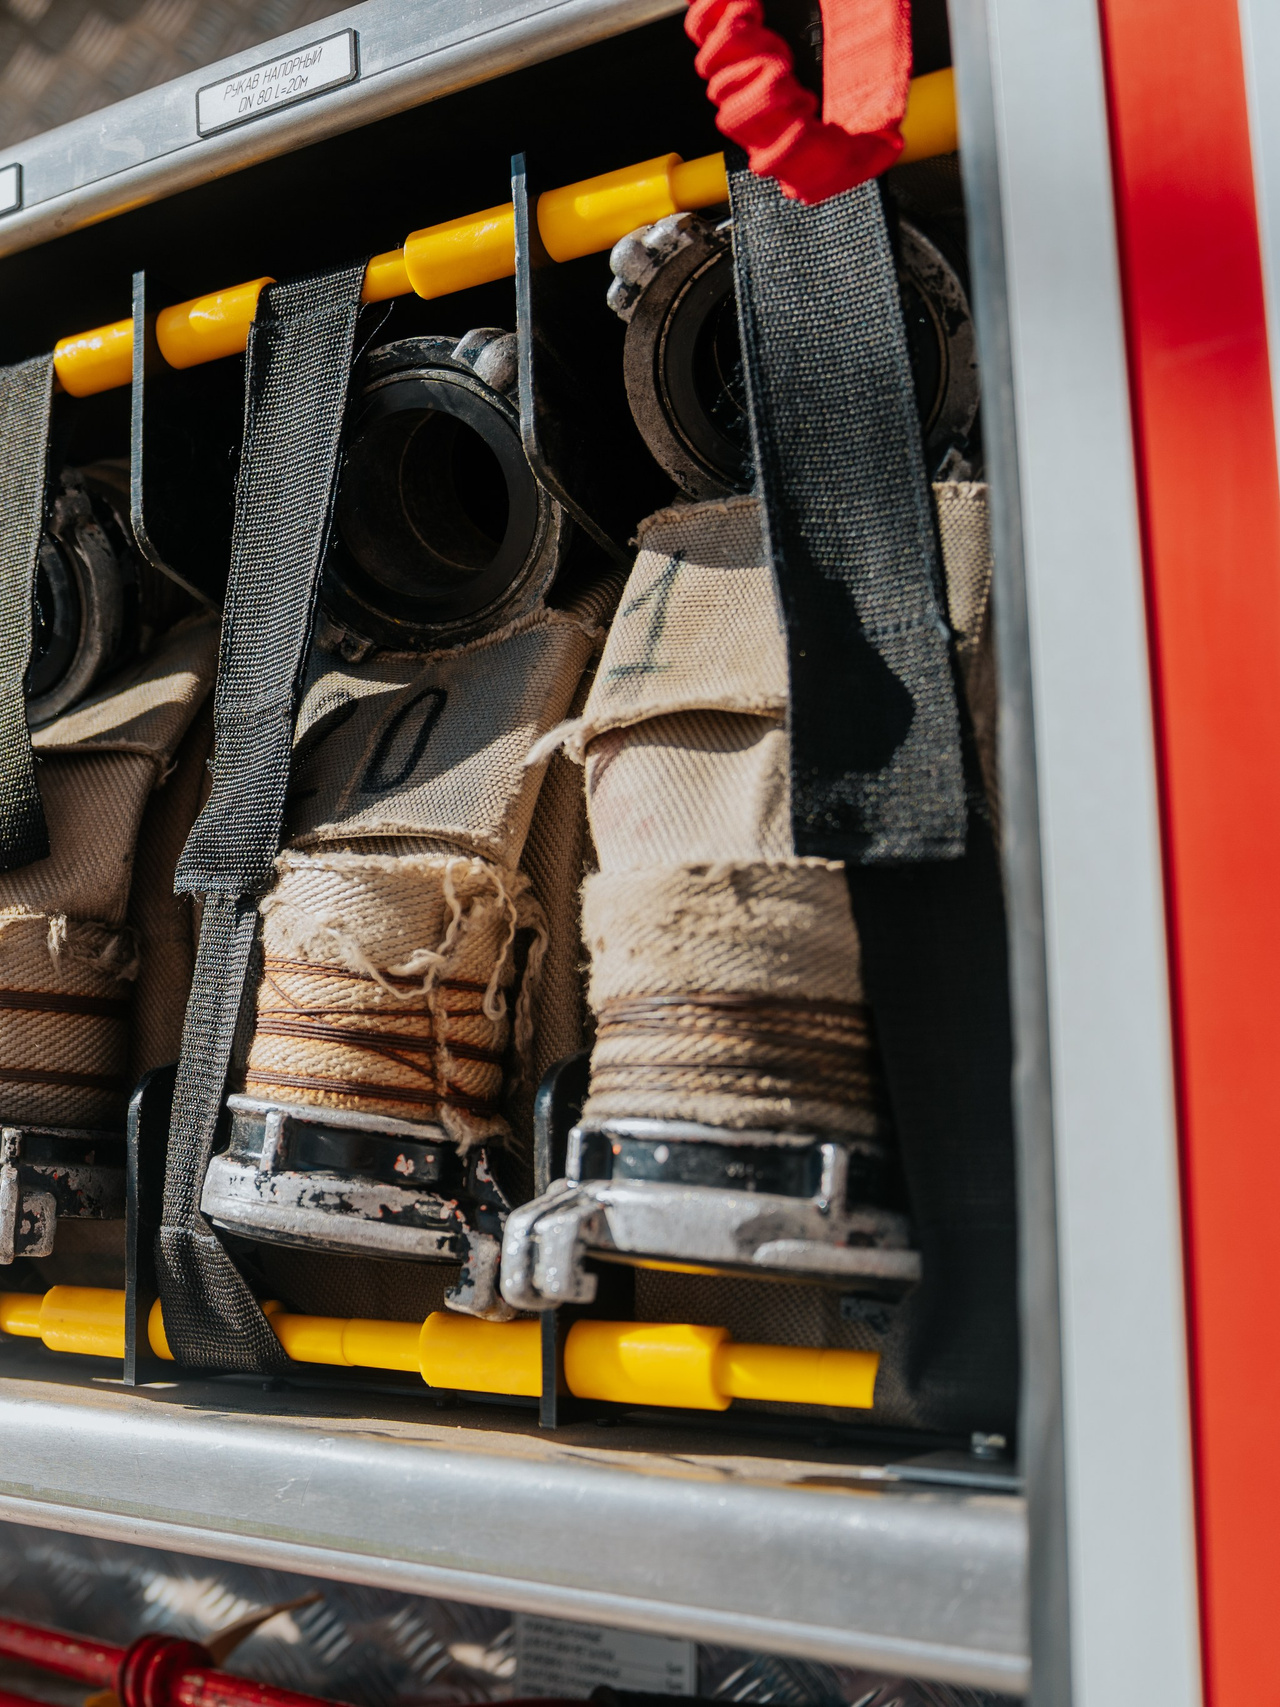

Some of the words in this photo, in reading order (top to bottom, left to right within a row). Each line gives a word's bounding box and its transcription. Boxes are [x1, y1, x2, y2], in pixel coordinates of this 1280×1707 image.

[224, 73, 260, 100] РУКАВ
[263, 46, 323, 83] НАПОРНЫЙ
[238, 96, 256, 113] DN
[257, 86, 273, 106] 80
